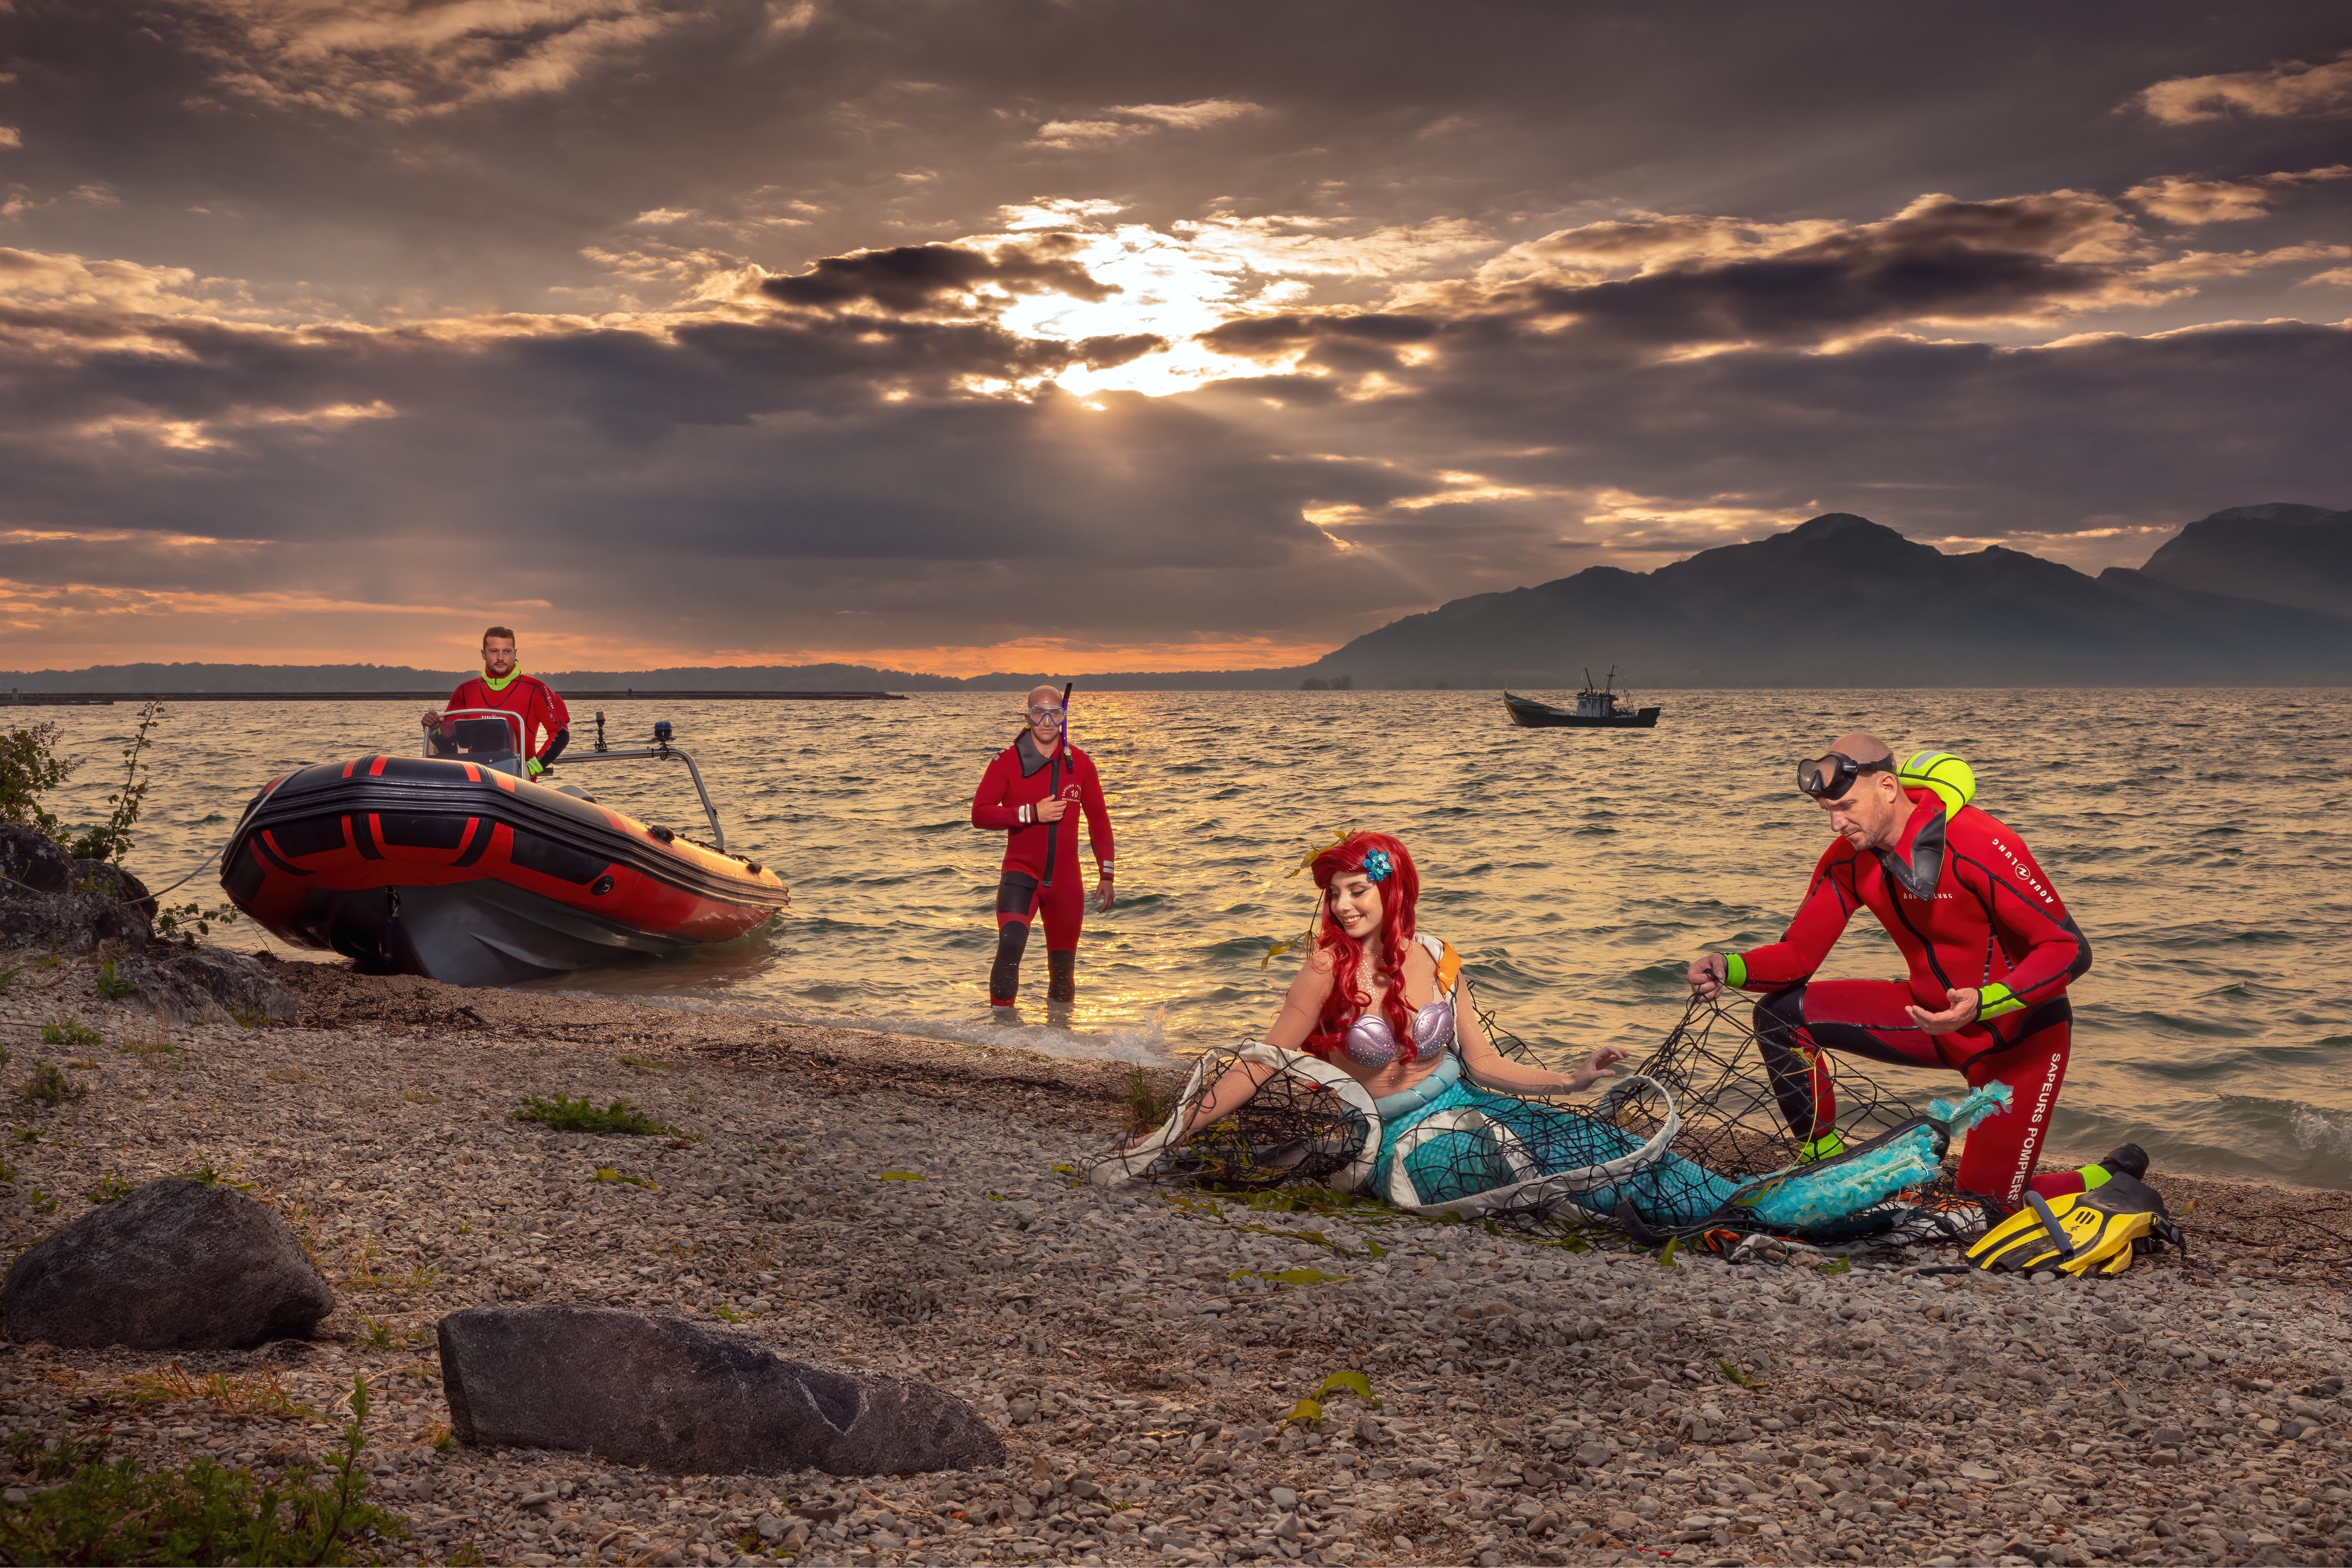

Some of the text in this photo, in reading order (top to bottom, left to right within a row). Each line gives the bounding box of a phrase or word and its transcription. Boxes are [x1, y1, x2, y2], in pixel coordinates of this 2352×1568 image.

[1062, 784, 1074, 796] SAPEURS
[1992, 838, 2054, 904] AQUA LUNG
[2032, 1053, 2061, 1123] SAPEURS
